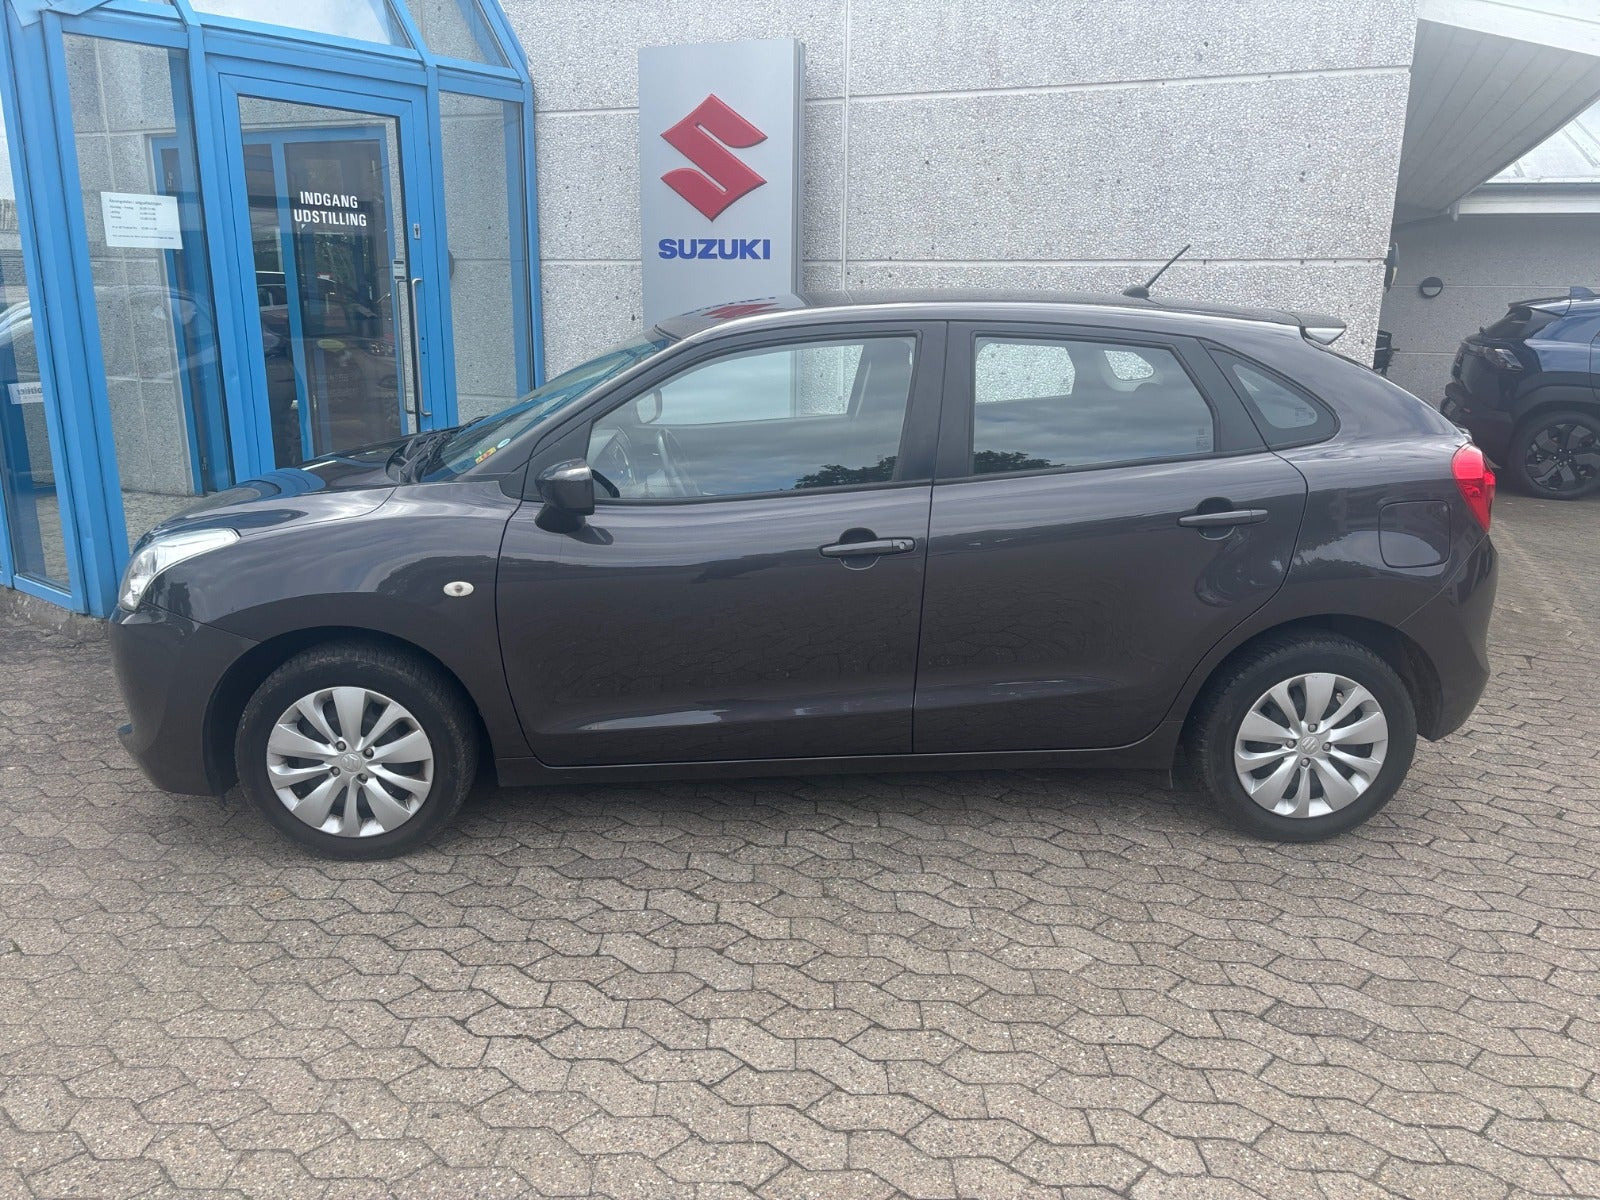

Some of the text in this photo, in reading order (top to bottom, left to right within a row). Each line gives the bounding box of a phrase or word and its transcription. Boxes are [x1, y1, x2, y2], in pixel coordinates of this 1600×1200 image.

[300, 191, 358, 208] INDGANG
[293, 208, 367, 227] UDSTILLING
[658, 238, 771, 260] SUZUKI
